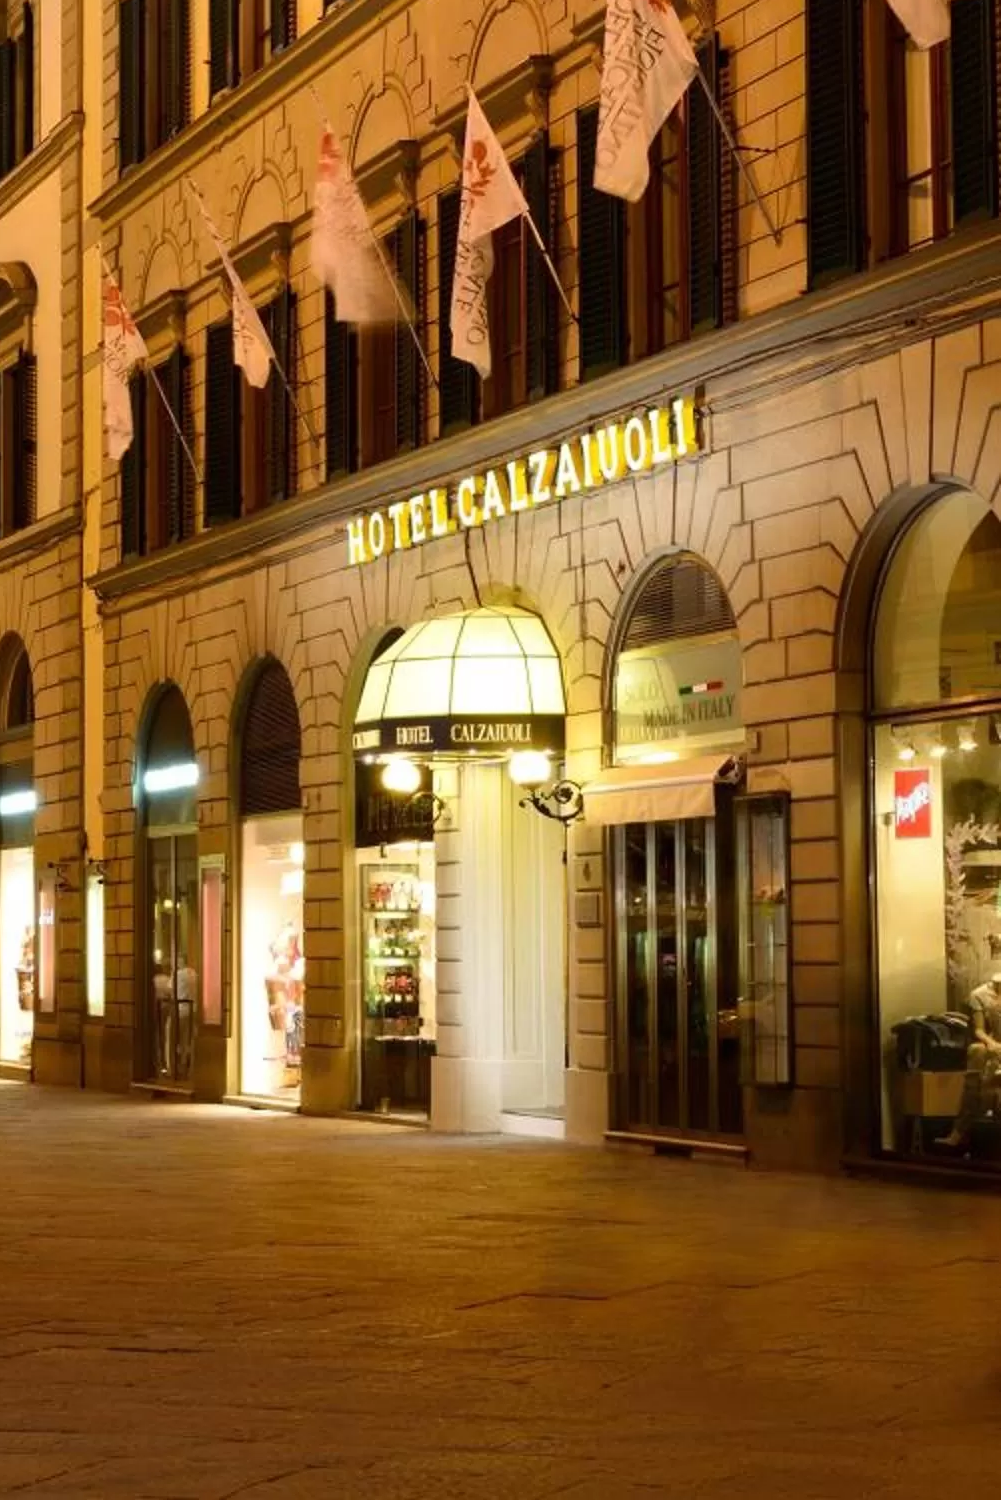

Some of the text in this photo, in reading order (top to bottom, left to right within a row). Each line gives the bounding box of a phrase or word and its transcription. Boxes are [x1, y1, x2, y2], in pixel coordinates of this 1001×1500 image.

[346, 398, 692, 565] HOTEL CALZAIUOLI
[698, 693, 735, 722] ITALY
[395, 725, 434, 745] HOTEL
[450, 723, 532, 743] CALZAIUOLI
